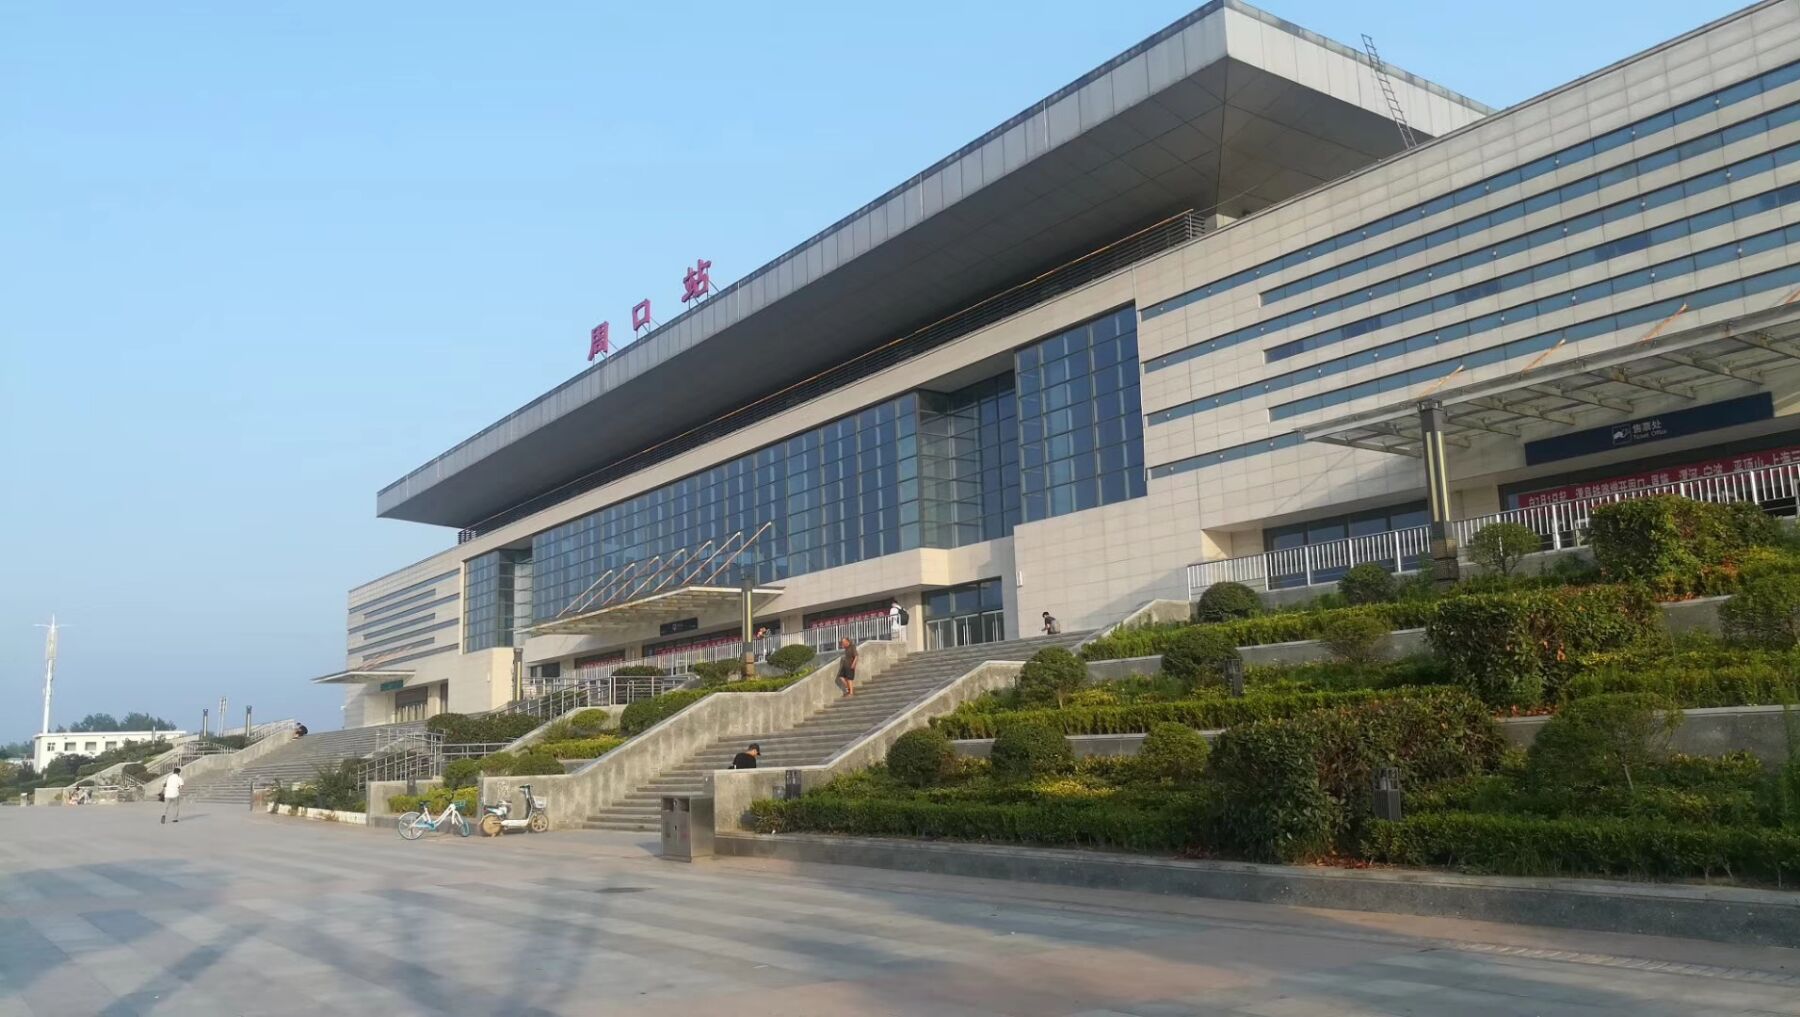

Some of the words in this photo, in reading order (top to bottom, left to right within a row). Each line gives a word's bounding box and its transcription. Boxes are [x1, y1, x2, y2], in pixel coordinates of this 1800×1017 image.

[588, 259, 711, 361] 周口站
[1632, 419, 1662, 434] 售票处
